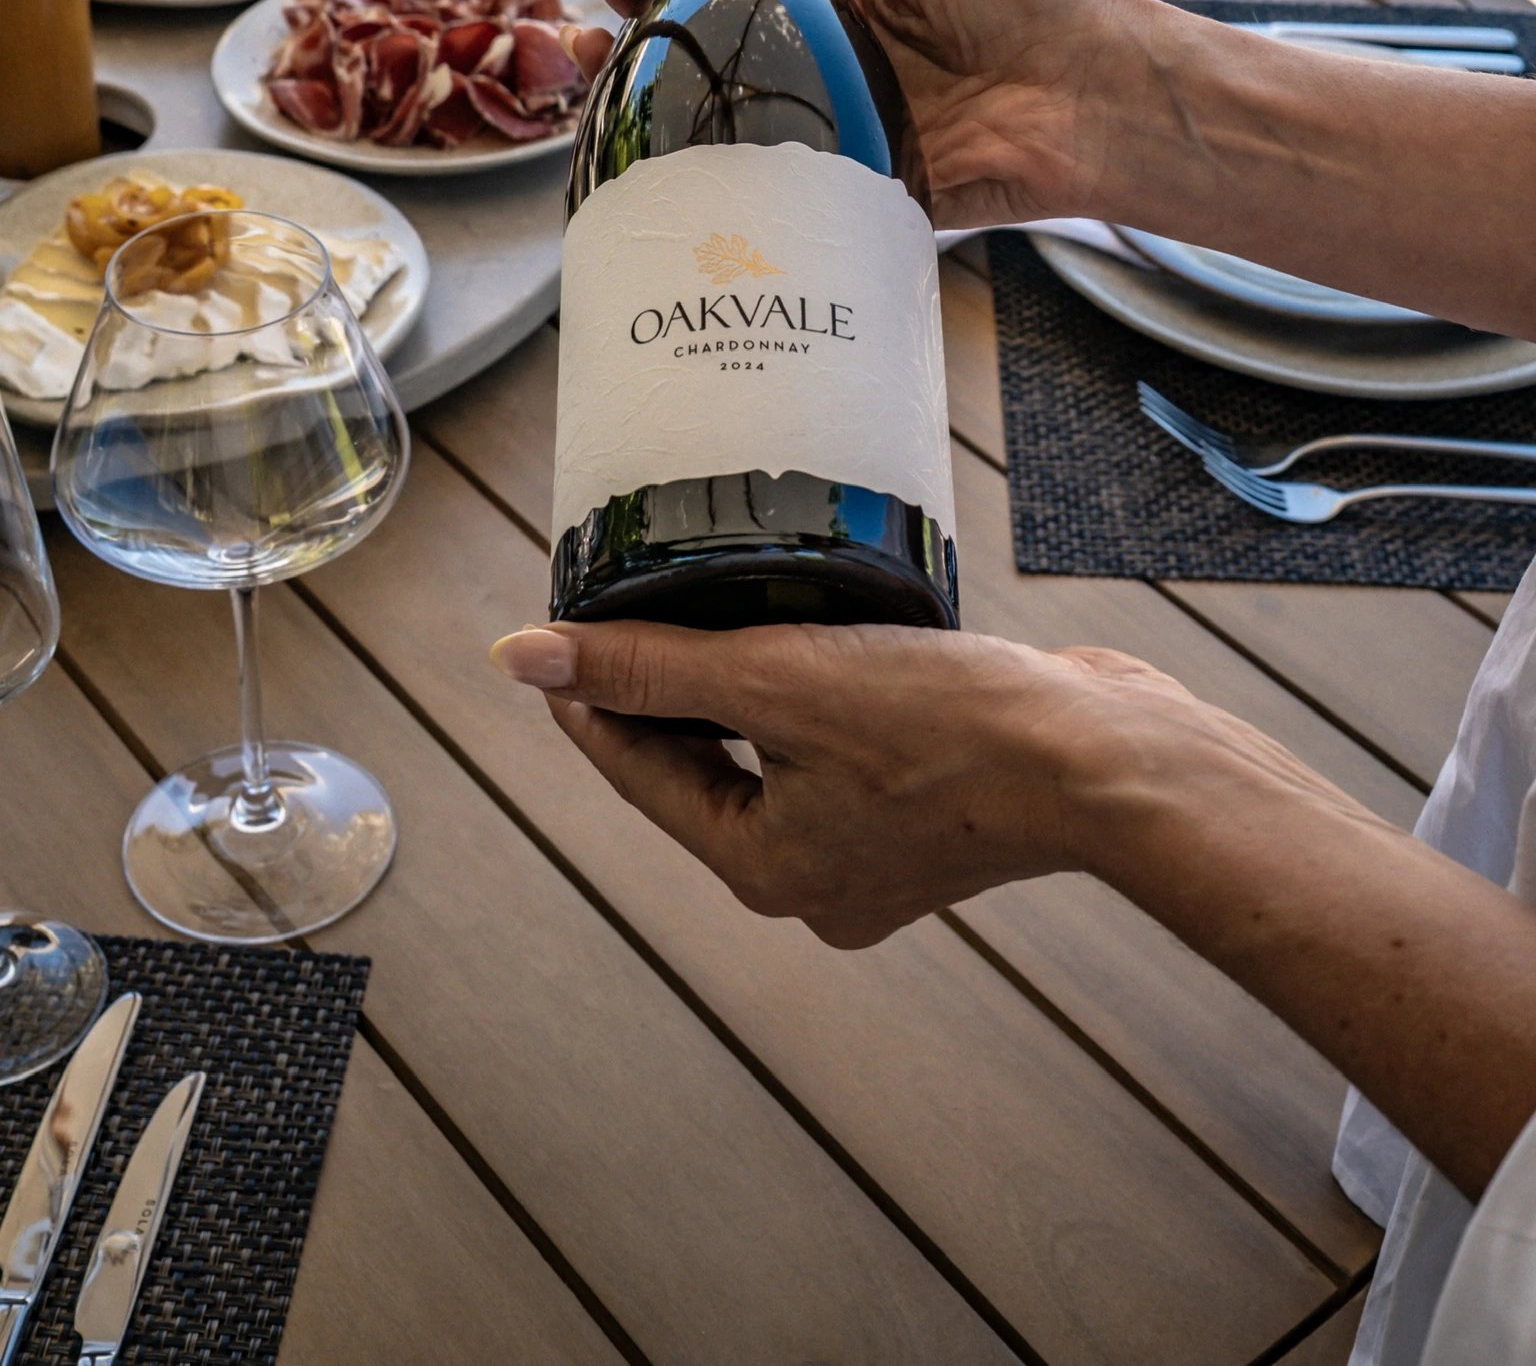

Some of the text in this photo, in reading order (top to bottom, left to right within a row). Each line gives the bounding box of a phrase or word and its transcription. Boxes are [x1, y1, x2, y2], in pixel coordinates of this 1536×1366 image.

[631, 294, 856, 345] OAKVALE
[674, 339, 811, 358] CHARDONNAY
[719, 360, 765, 372] 2024
